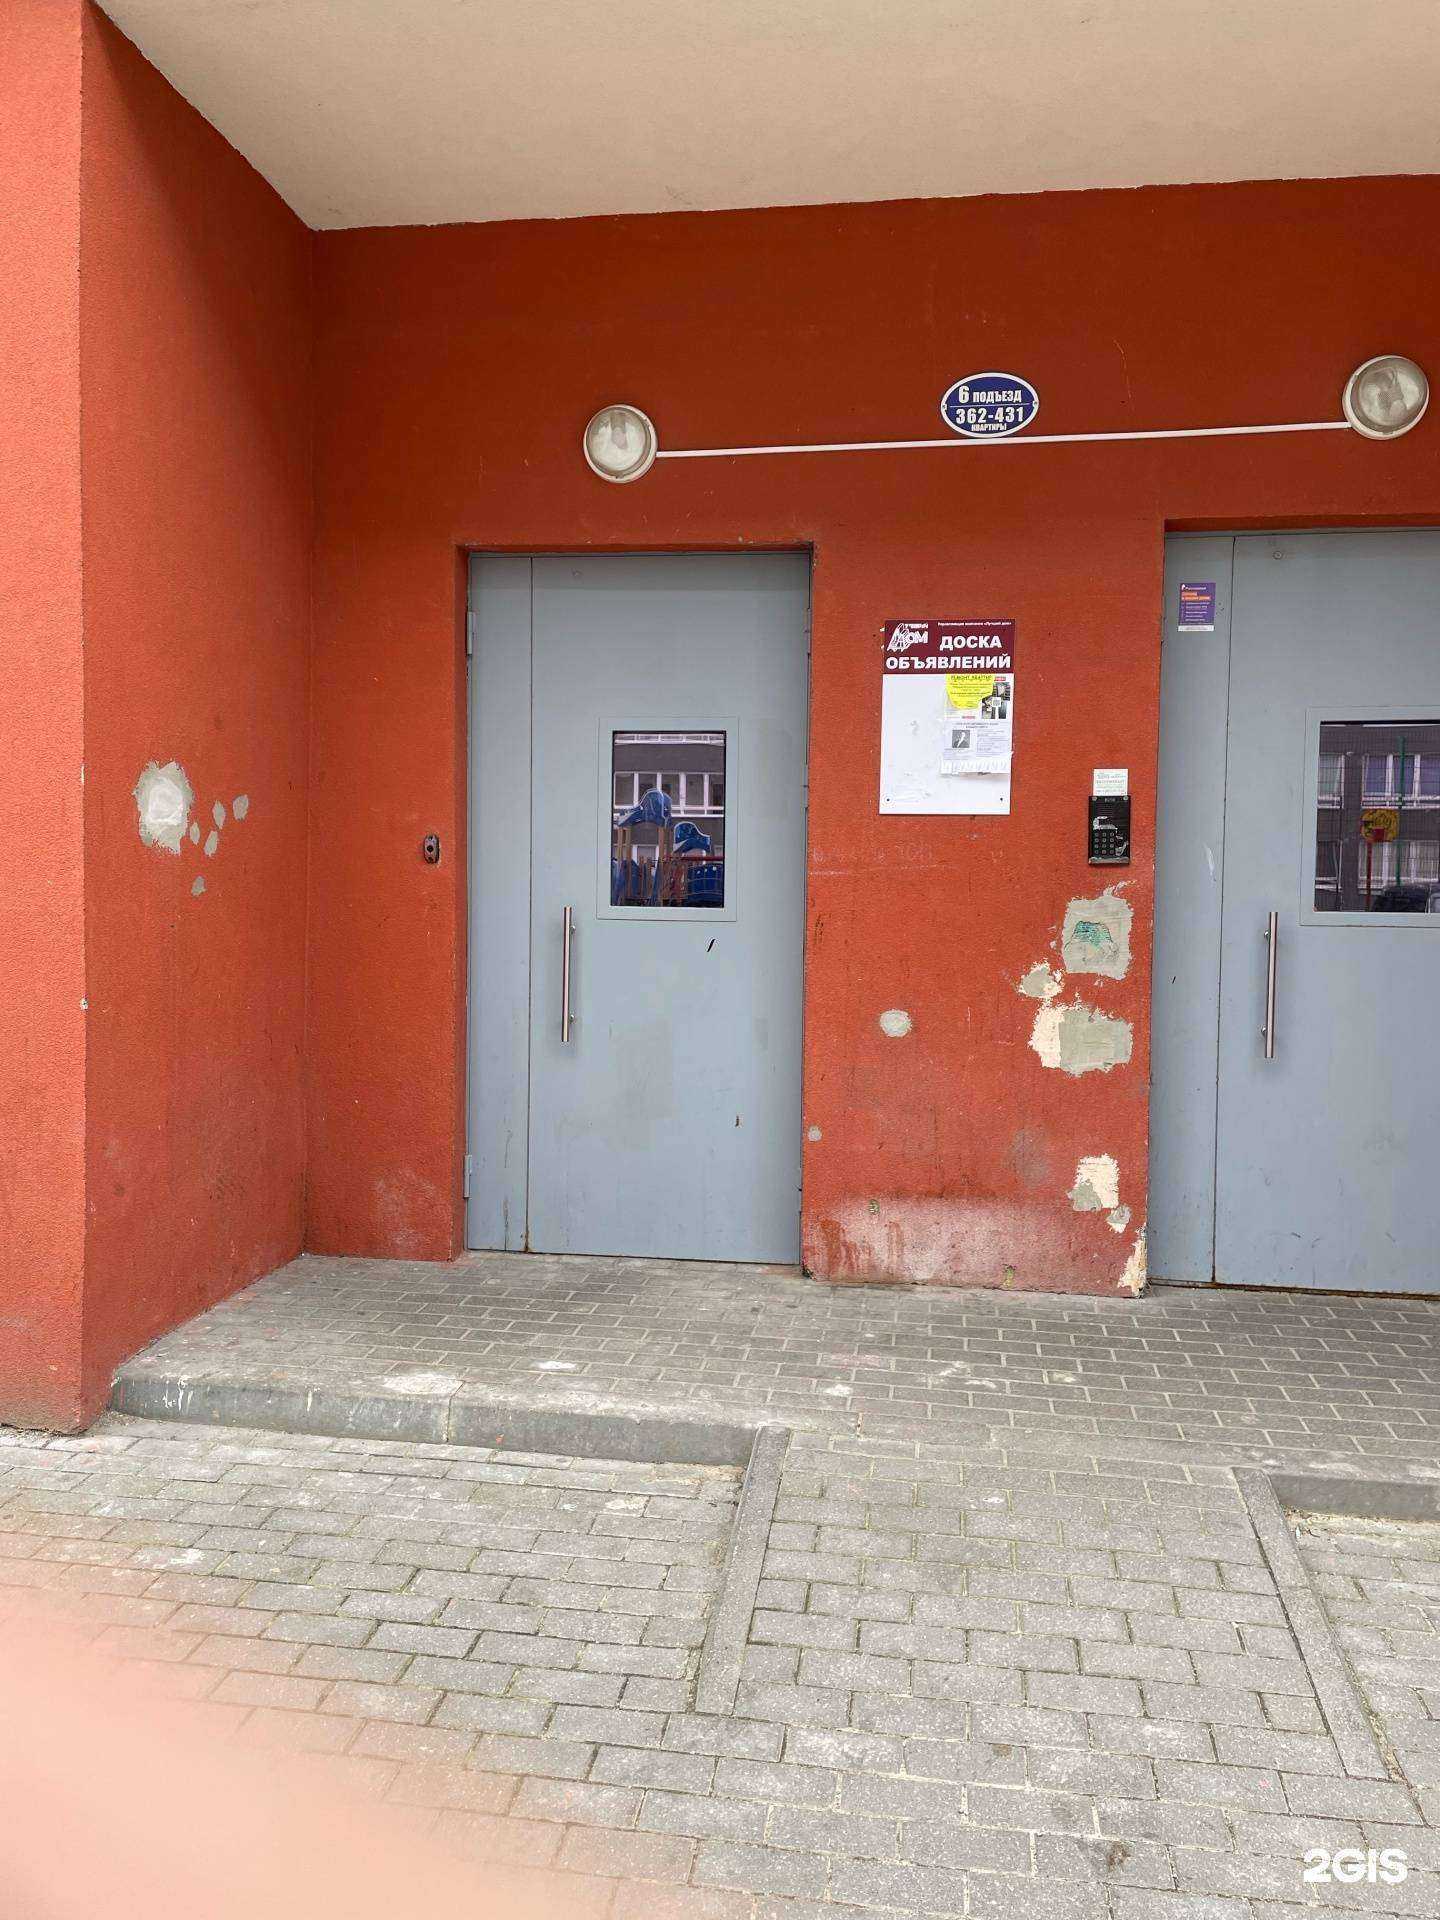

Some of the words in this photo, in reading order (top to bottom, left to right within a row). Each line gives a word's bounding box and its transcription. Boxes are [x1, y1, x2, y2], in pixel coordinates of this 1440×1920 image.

[958, 385, 970, 404] 6
[972, 390, 1022, 404] ПОДЪЕЗД
[955, 406, 1024, 424] 362-431
[971, 423, 1007, 432] КВАРТИРЫ
[939, 635, 1002, 651] ДОСКА
[886, 654, 1011, 669] ОБЪЯВЛЕНИЙ
